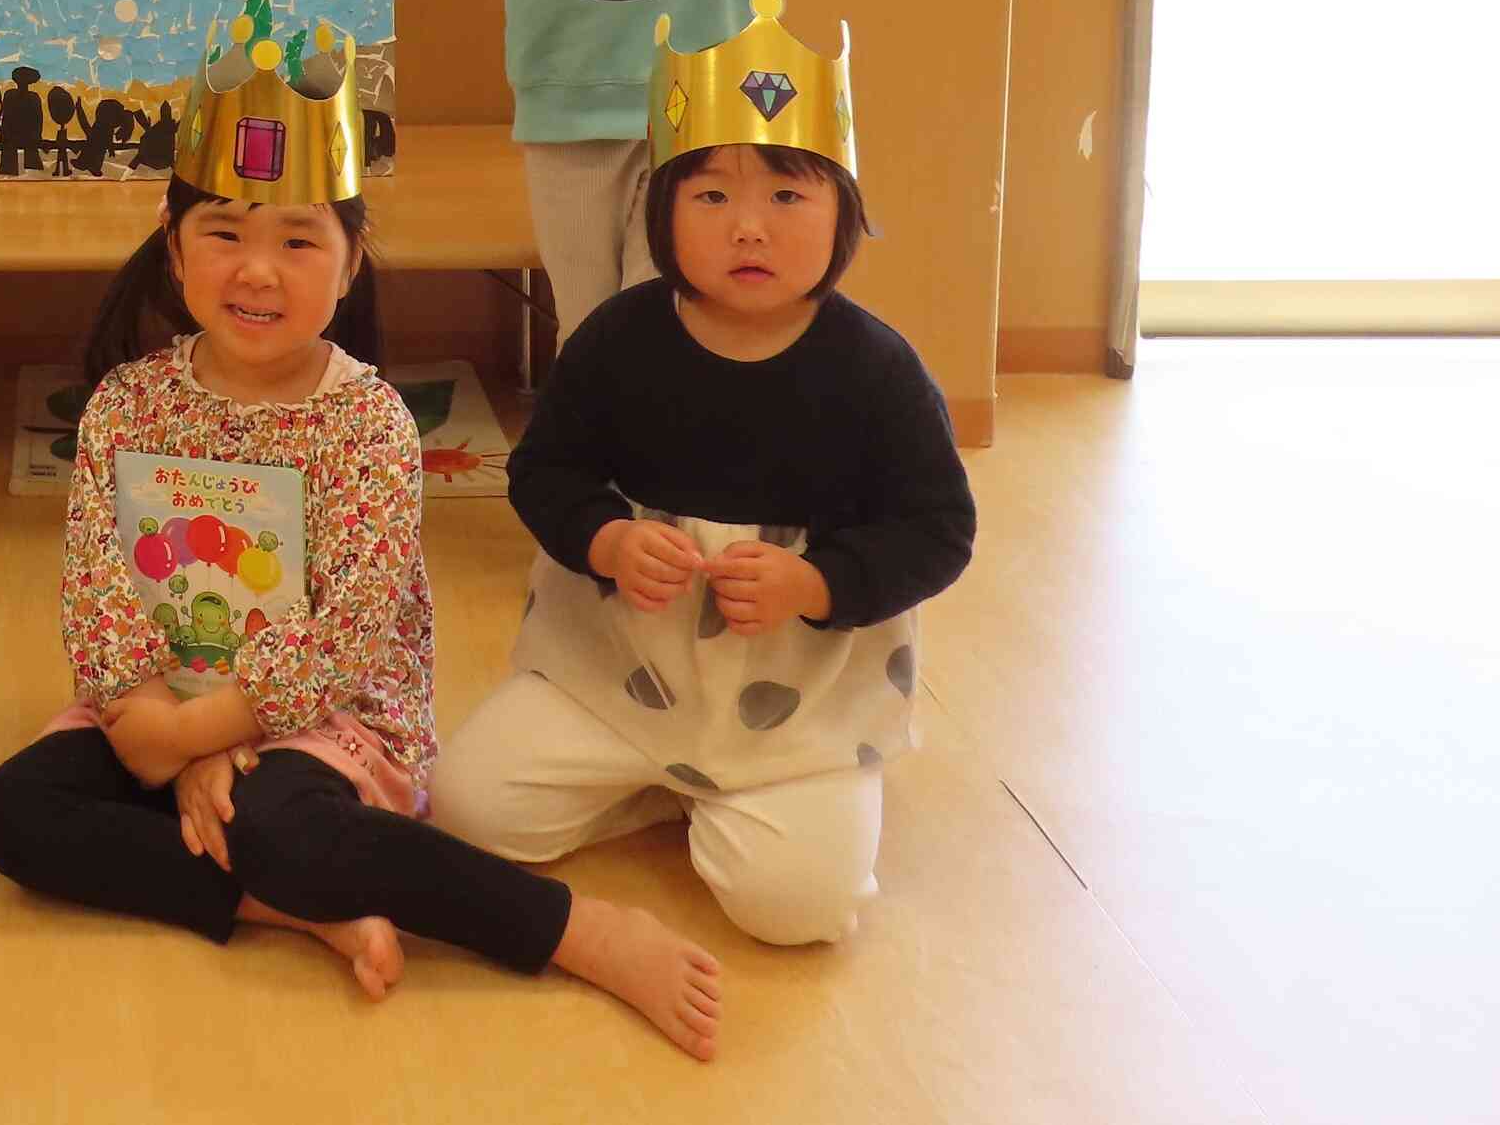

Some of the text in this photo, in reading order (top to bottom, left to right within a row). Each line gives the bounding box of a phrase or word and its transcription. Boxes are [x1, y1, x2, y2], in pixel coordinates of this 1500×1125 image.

[155, 466, 260, 494] おたんじょうび
[172, 491, 246, 514] おめでとう
